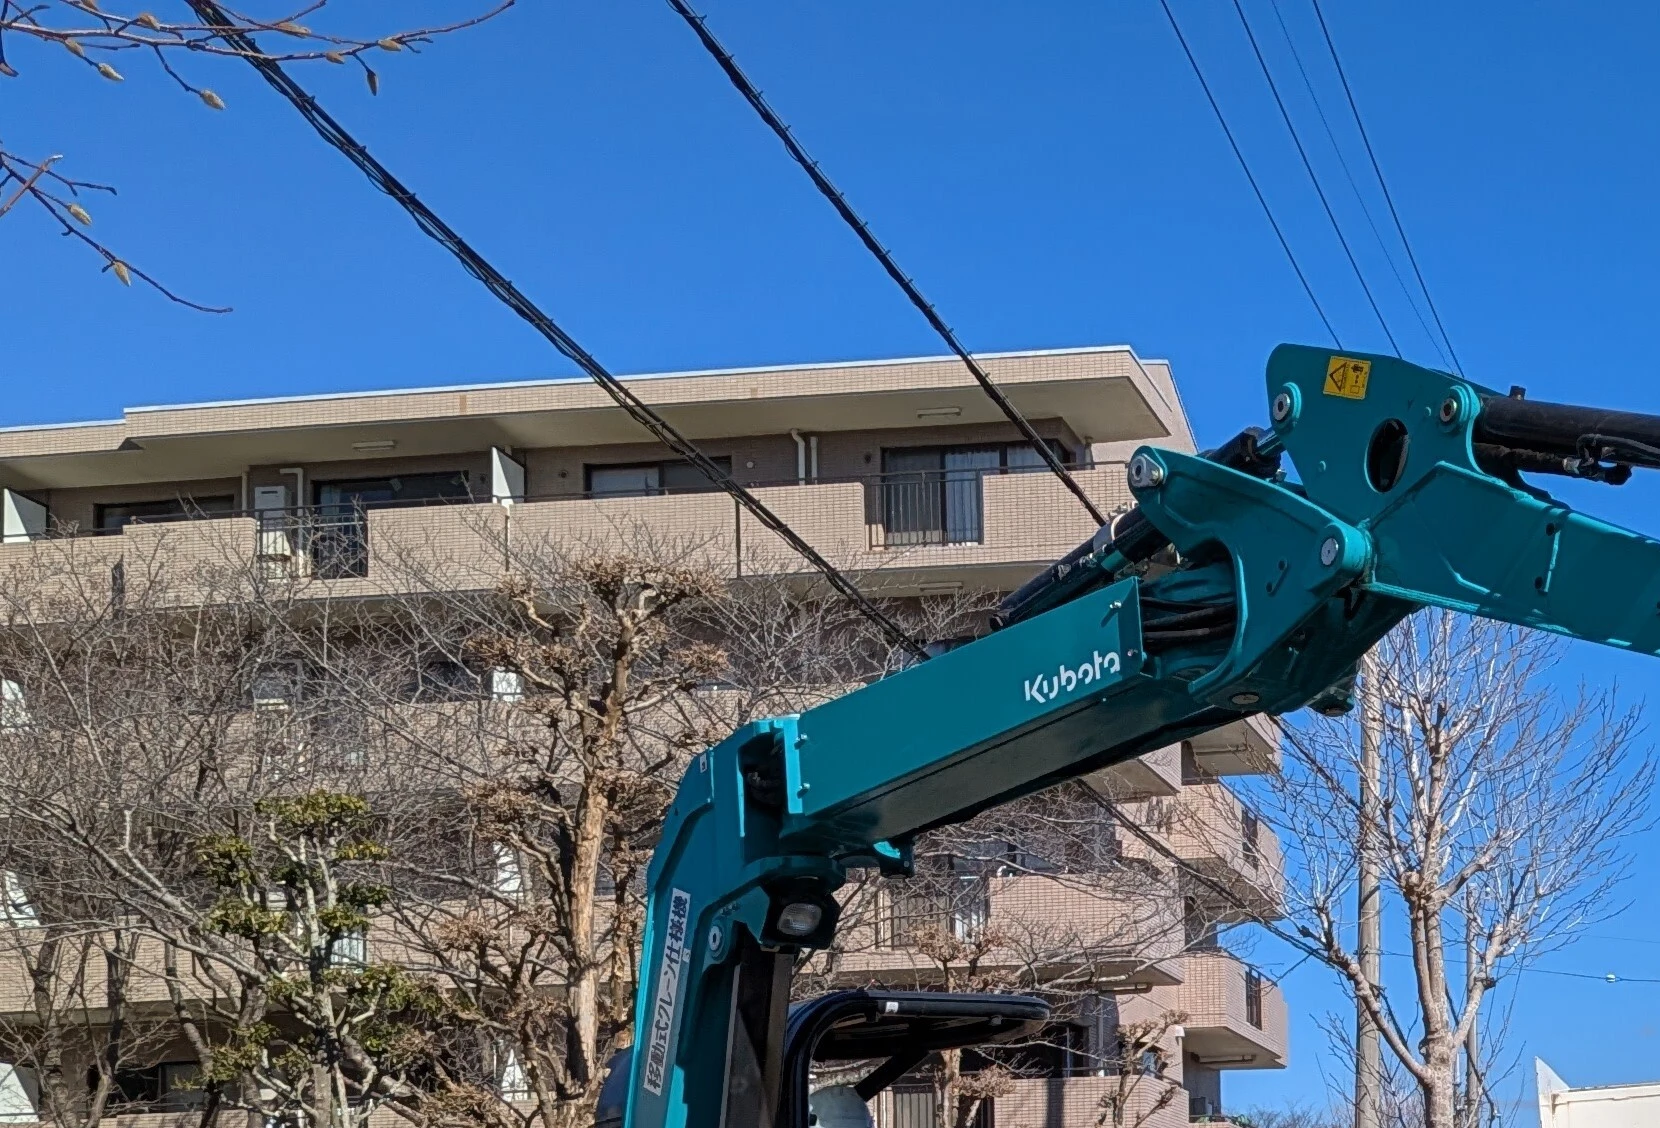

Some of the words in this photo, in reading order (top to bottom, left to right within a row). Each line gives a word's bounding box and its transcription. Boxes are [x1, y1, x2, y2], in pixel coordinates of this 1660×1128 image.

[1024, 650, 1121, 704] Kubota
[646, 895, 688, 1090] 移動式クレーン仕様機
